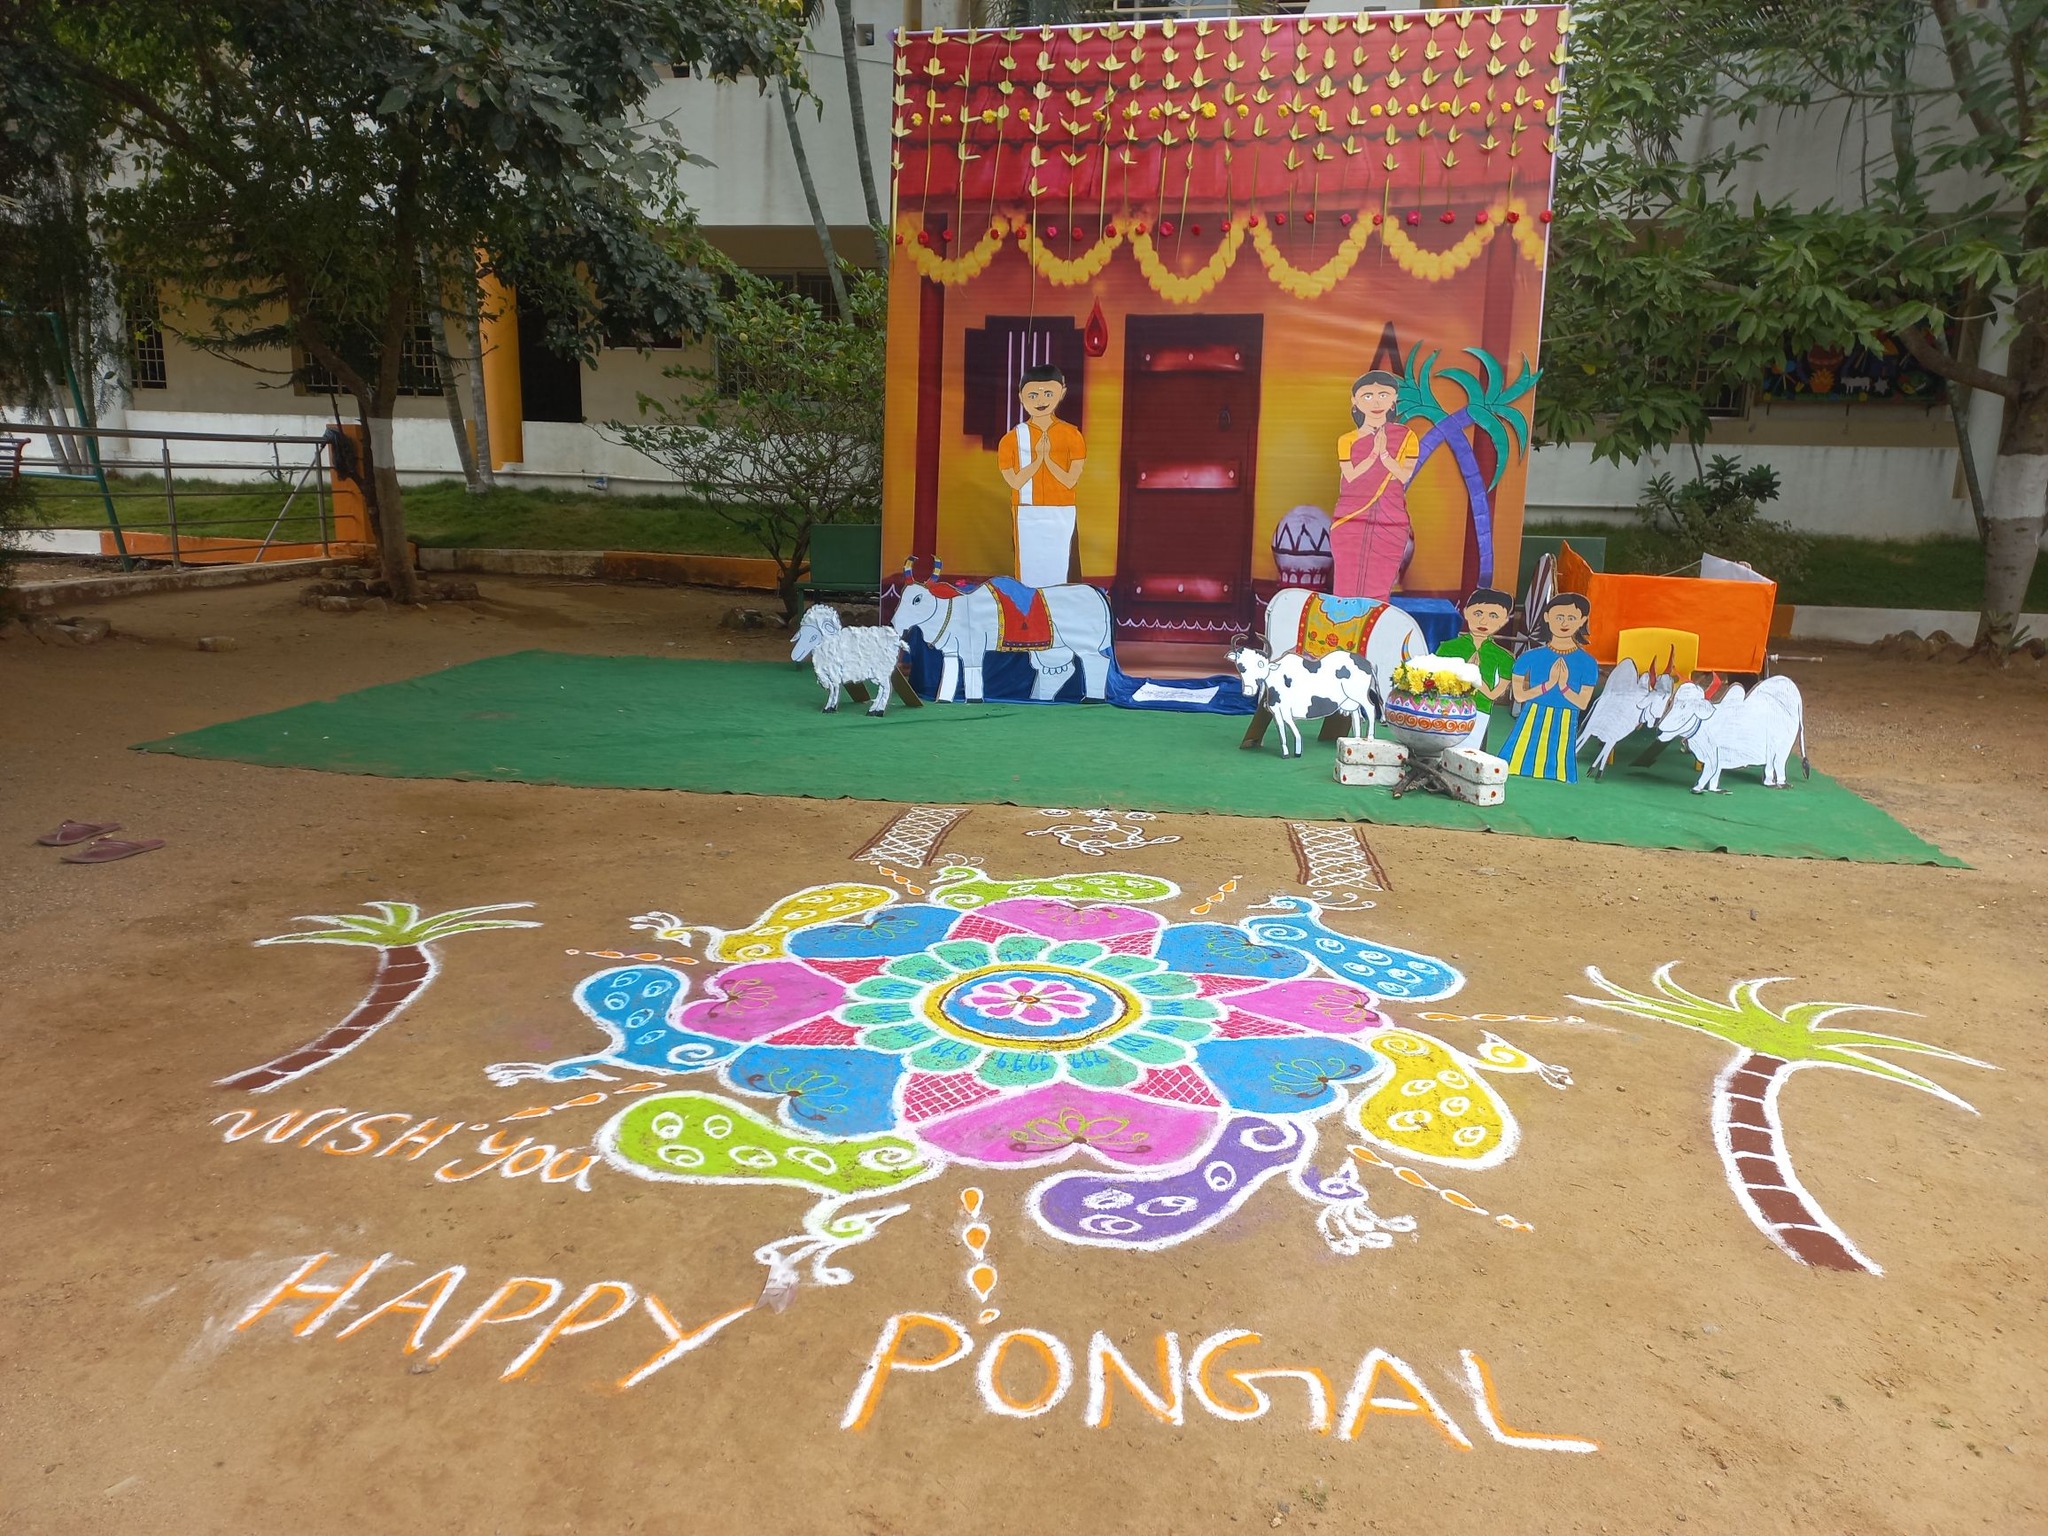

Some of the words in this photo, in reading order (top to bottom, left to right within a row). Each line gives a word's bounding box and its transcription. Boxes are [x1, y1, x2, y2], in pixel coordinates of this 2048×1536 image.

[210, 1107, 465, 1161] WISH
[229, 1251, 756, 1389] HAPPY
[840, 1311, 1598, 1454] PONGAL
